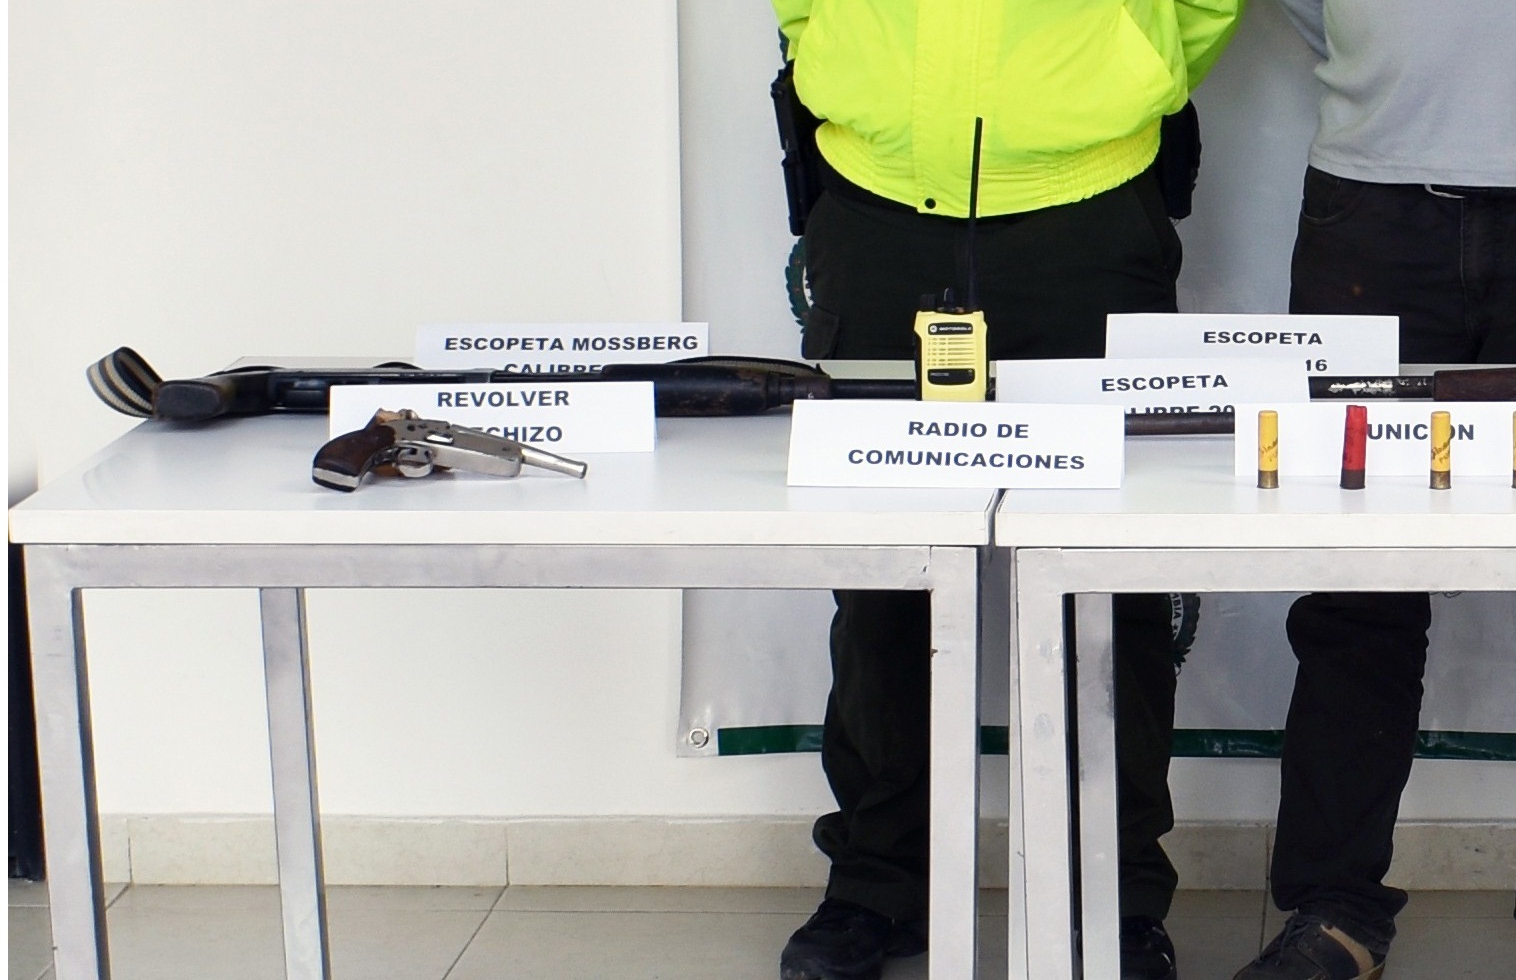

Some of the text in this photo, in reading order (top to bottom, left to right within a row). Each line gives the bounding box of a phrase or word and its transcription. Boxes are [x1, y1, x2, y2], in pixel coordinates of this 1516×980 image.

[444, 335, 698, 351] ESCOPETA MOSSBERG
[1204, 331, 1323, 345] ESCOPETA
[1101, 375, 1228, 392] ESCOPETA
[437, 390, 570, 407] REVOLVER
[908, 421, 1029, 439] RADIO DE
[848, 449, 1085, 470] COMUNICACIONES
